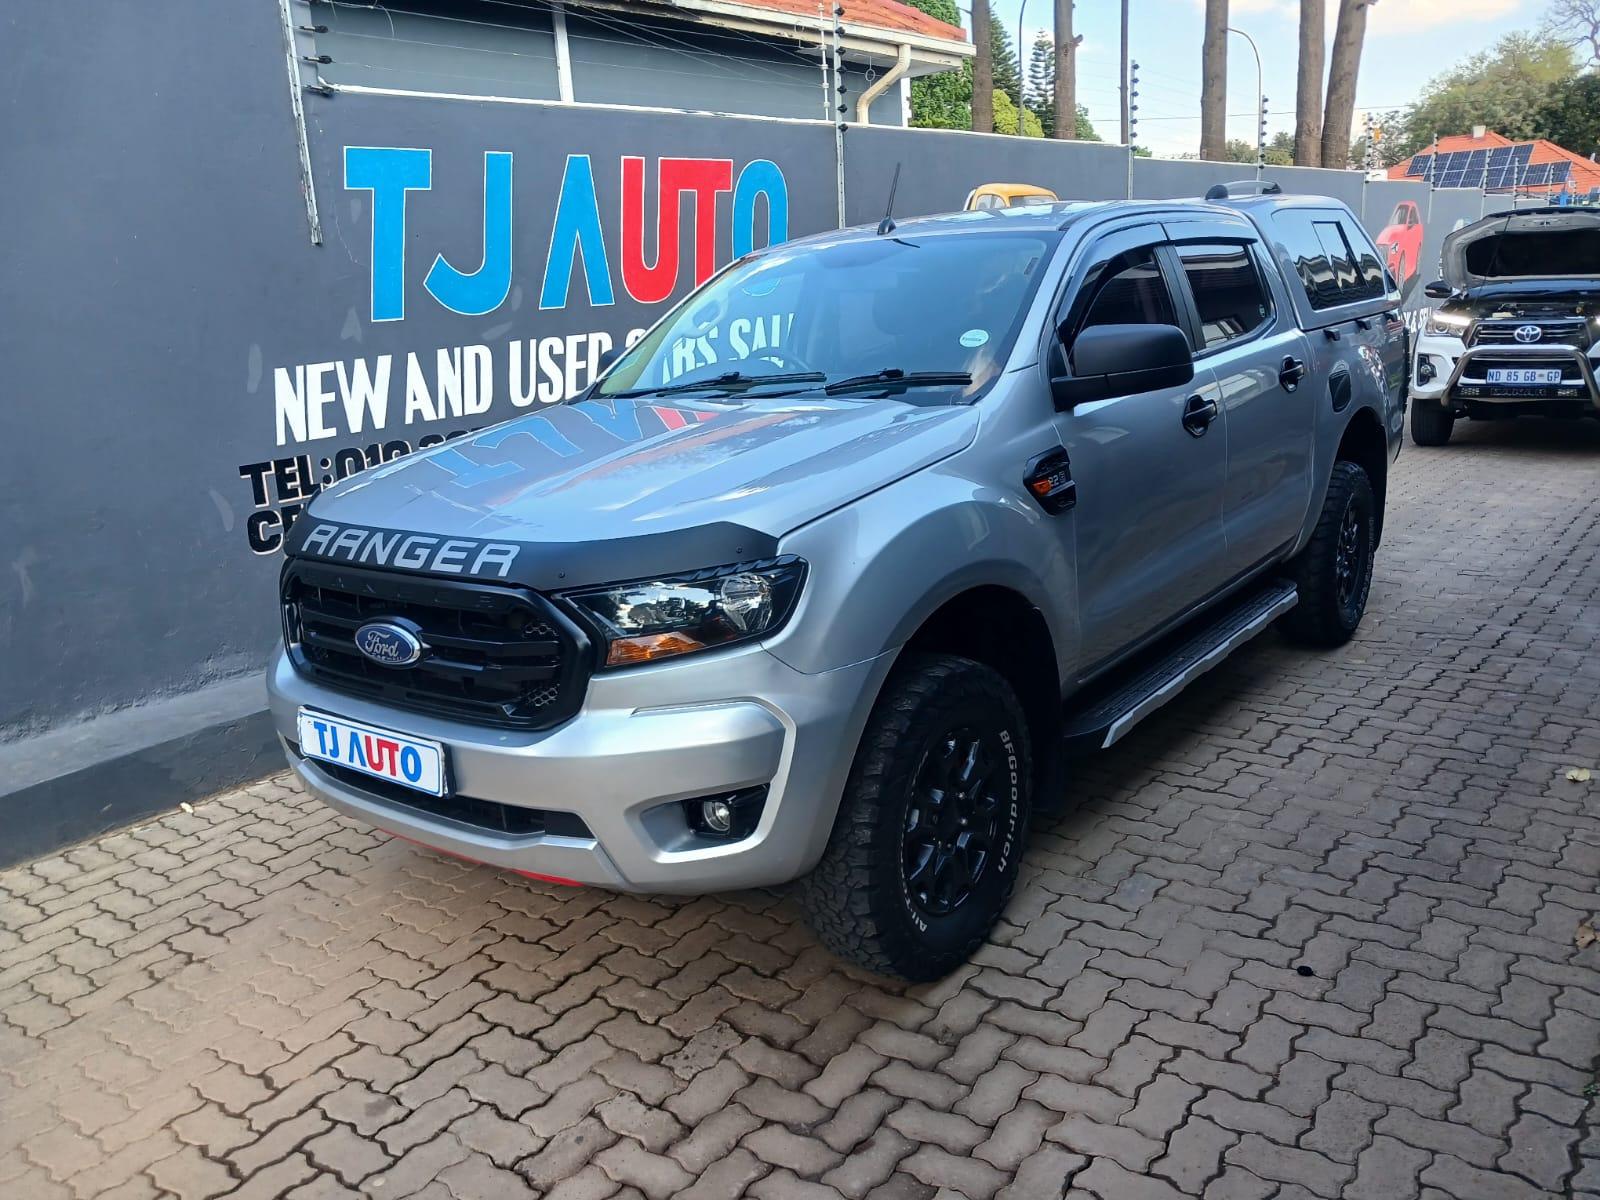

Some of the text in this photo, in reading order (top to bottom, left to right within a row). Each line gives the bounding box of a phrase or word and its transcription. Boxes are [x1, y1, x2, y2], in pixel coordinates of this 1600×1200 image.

[343, 145, 789, 322] TJ AUTO
[274, 355, 392, 446] NEW
[404, 344, 492, 425] AND
[301, 524, 521, 579] RANGER
[364, 630, 399, 657] Ford
[313, 720, 422, 783] TJ AUTO
